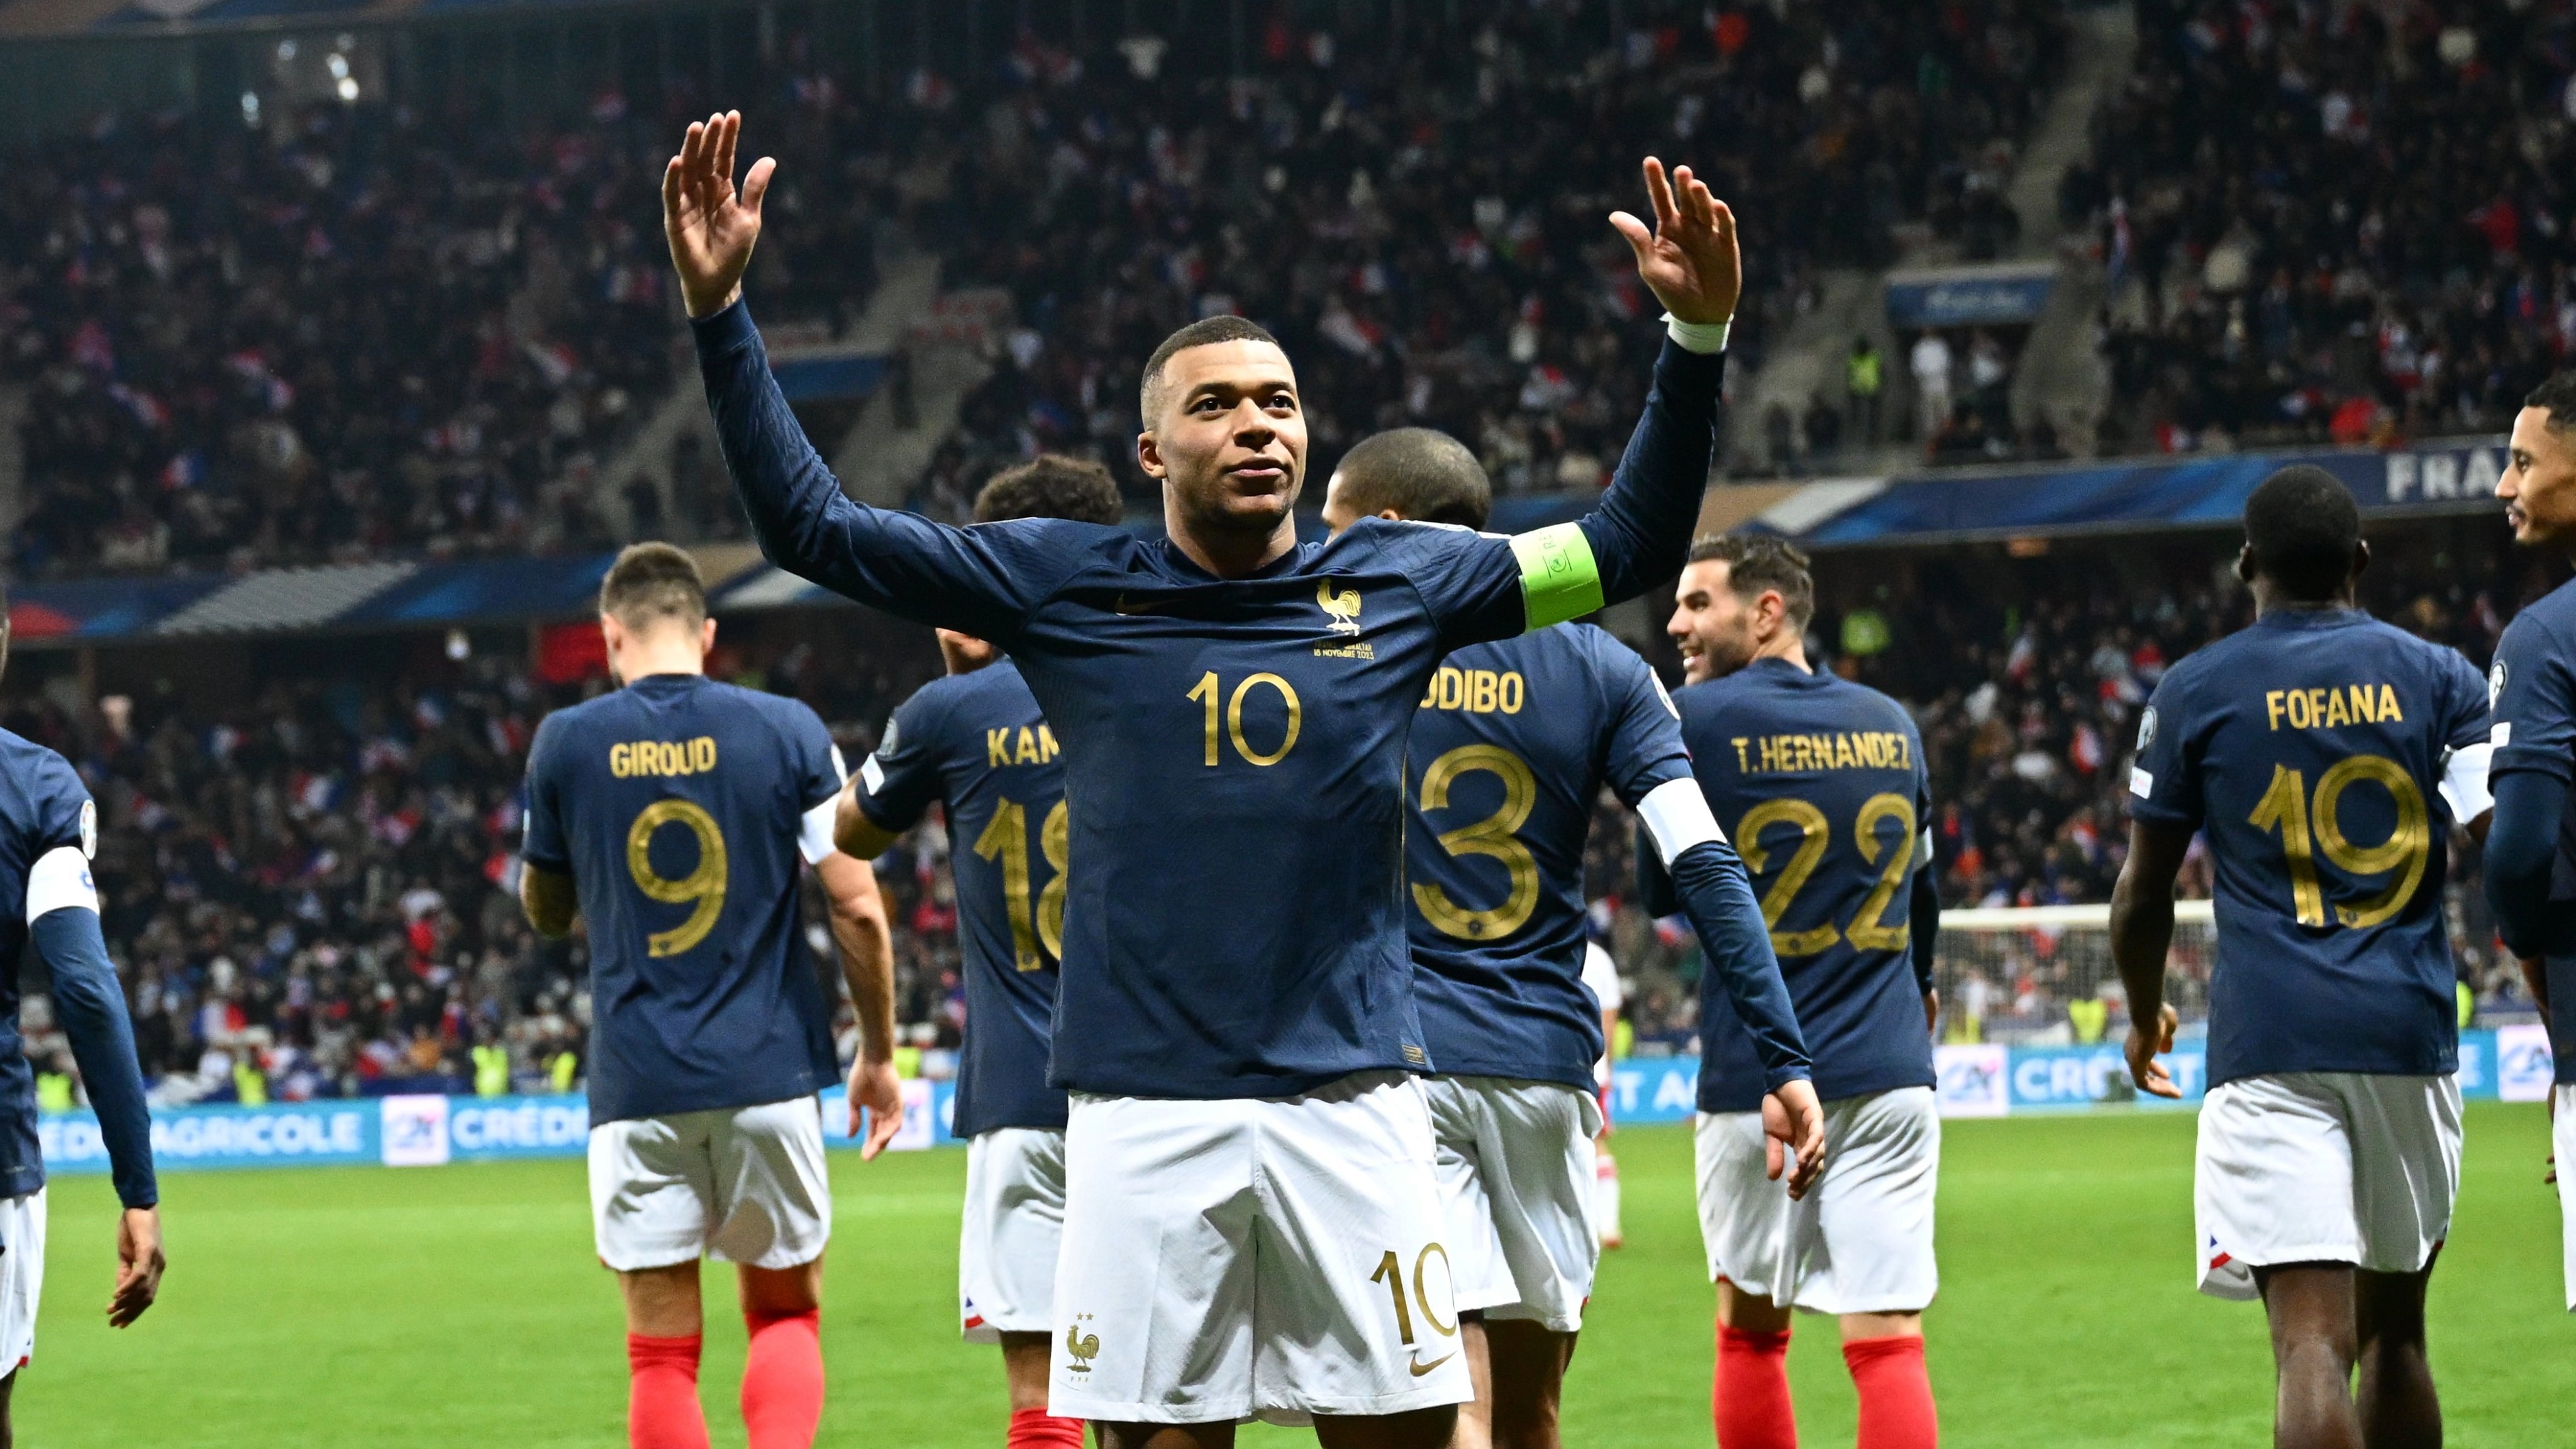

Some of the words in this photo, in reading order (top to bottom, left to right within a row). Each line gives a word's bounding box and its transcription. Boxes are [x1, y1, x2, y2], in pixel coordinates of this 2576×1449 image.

[2387, 447, 2512, 502] FRA
[1314, 648, 1321, 657] 18
[1357, 651, 1374, 660] 2023
[609, 735, 717, 779] GIROUD
[1185, 670, 1301, 767] 10
[2265, 684, 2403, 731] FOFANA
[626, 798, 728, 958] 9
[1411, 743, 1539, 941] 3
[1736, 792, 1916, 957] 22
[2248, 755, 2430, 930] 19
[1370, 1242, 1457, 1345] 10
